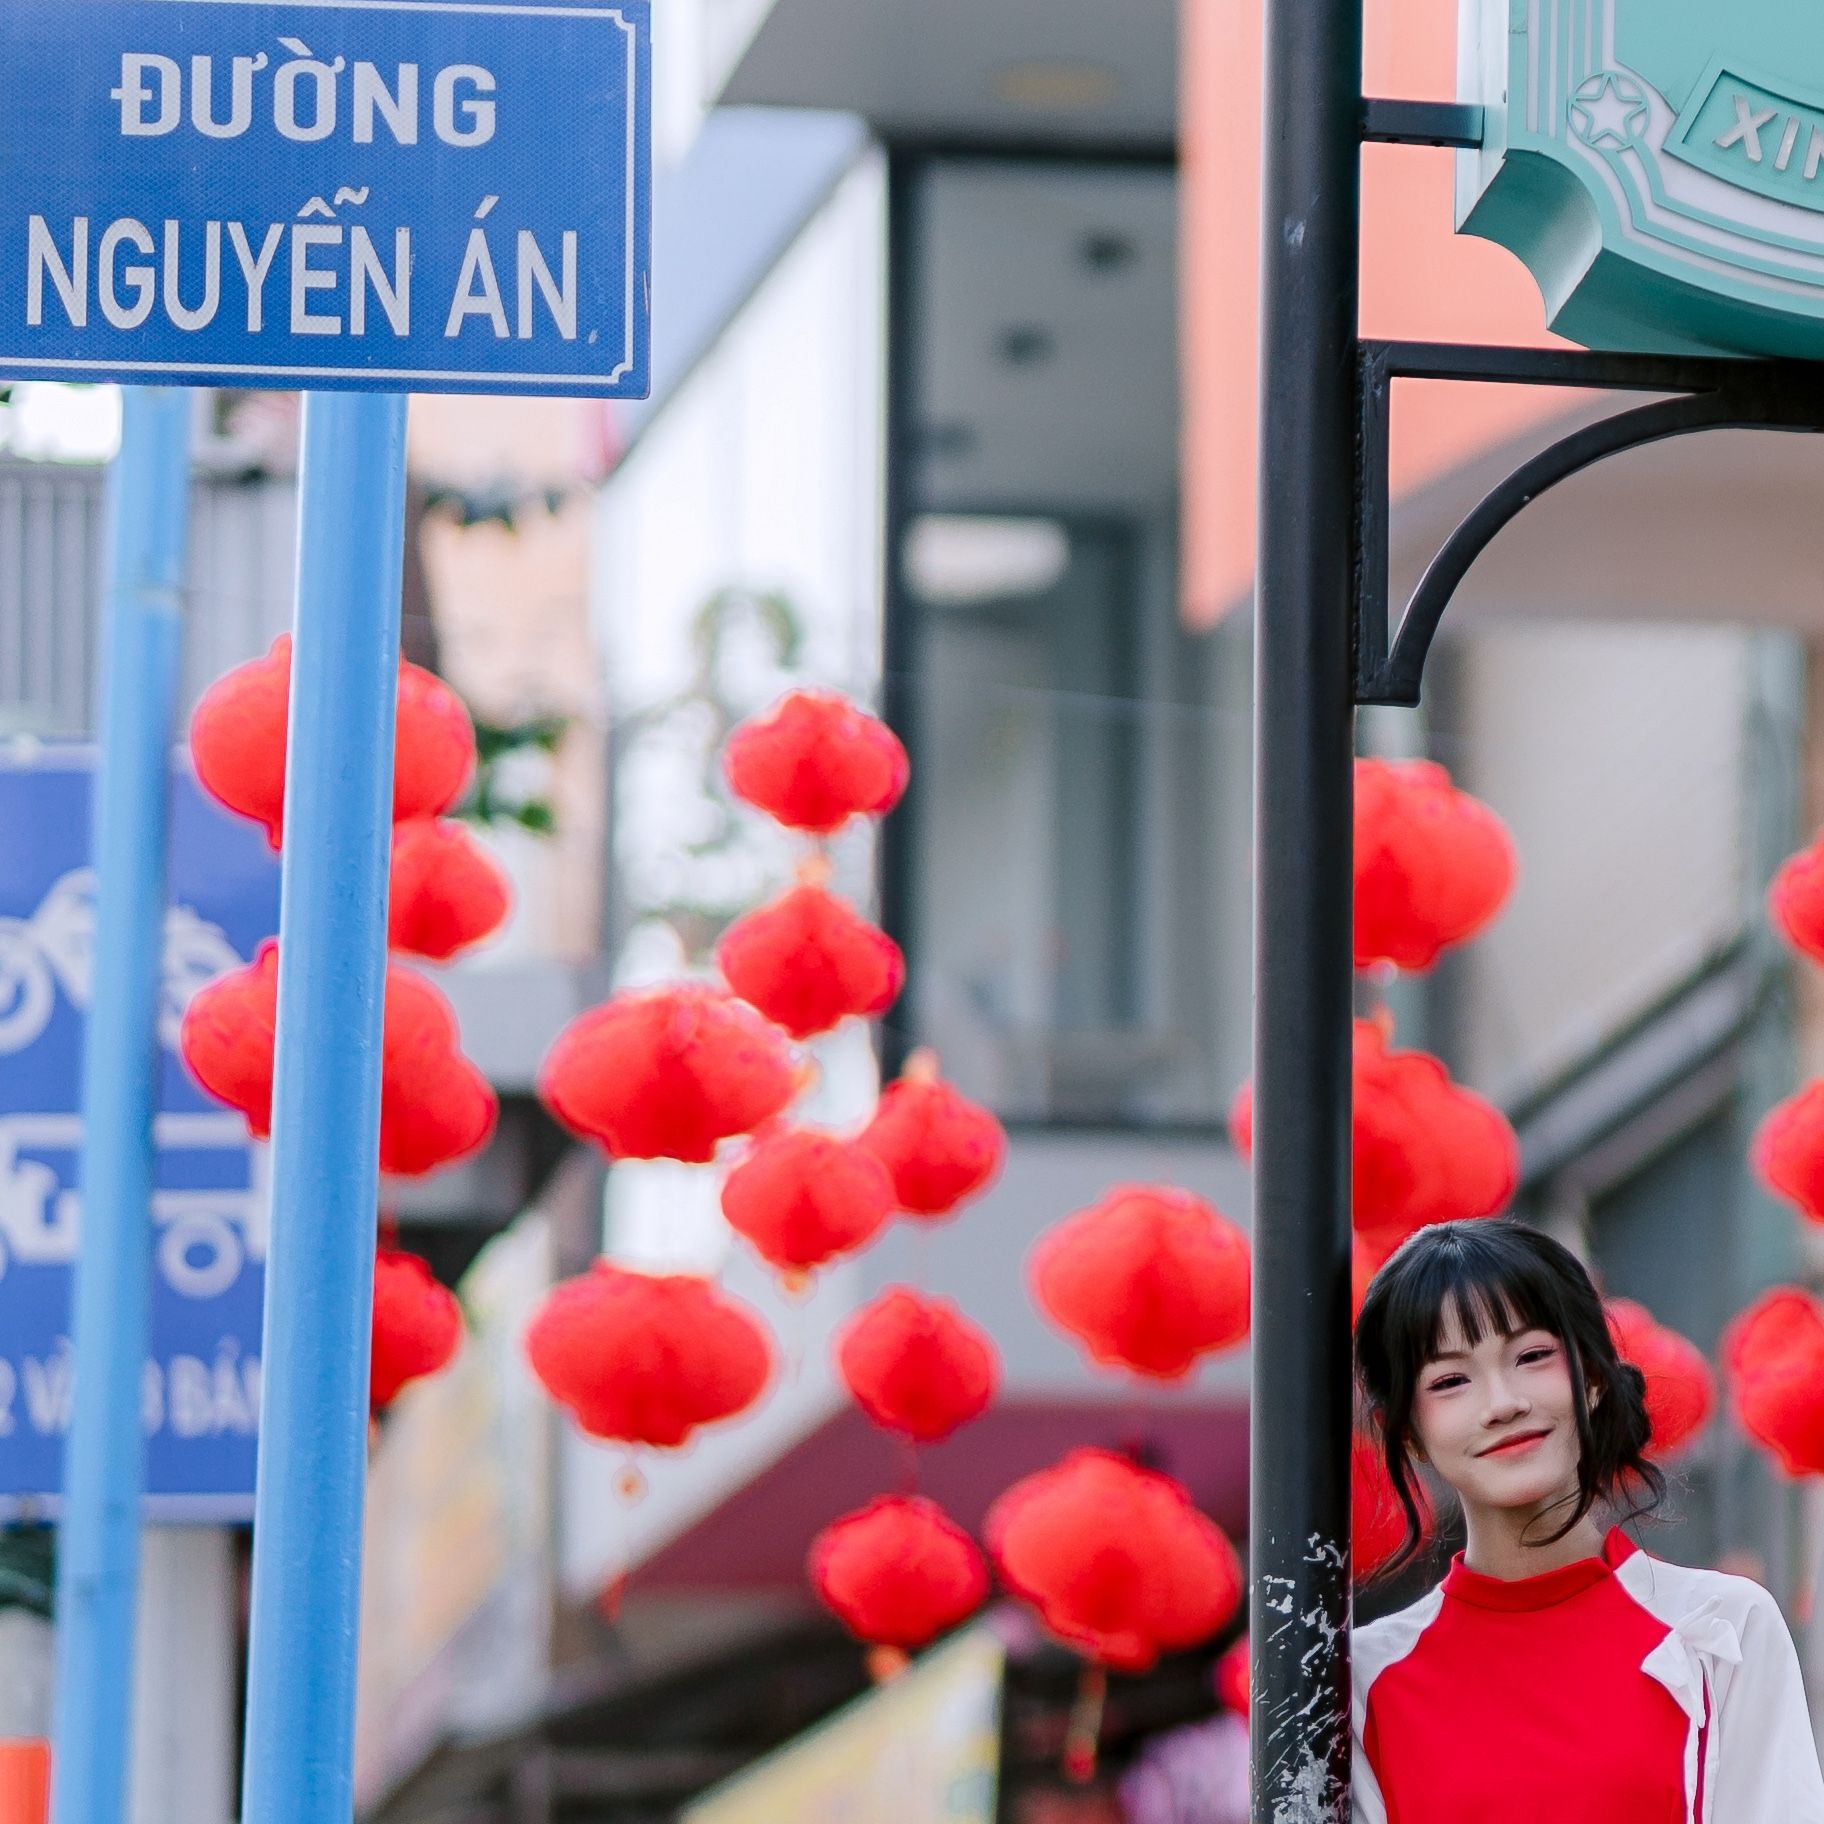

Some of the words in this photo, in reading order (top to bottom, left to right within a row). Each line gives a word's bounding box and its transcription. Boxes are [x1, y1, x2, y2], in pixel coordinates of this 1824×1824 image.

[111, 37, 498, 148] ĐƯỜNG
[26, 186, 411, 337] NGUYỄN
[443, 194, 579, 340] ÁN
